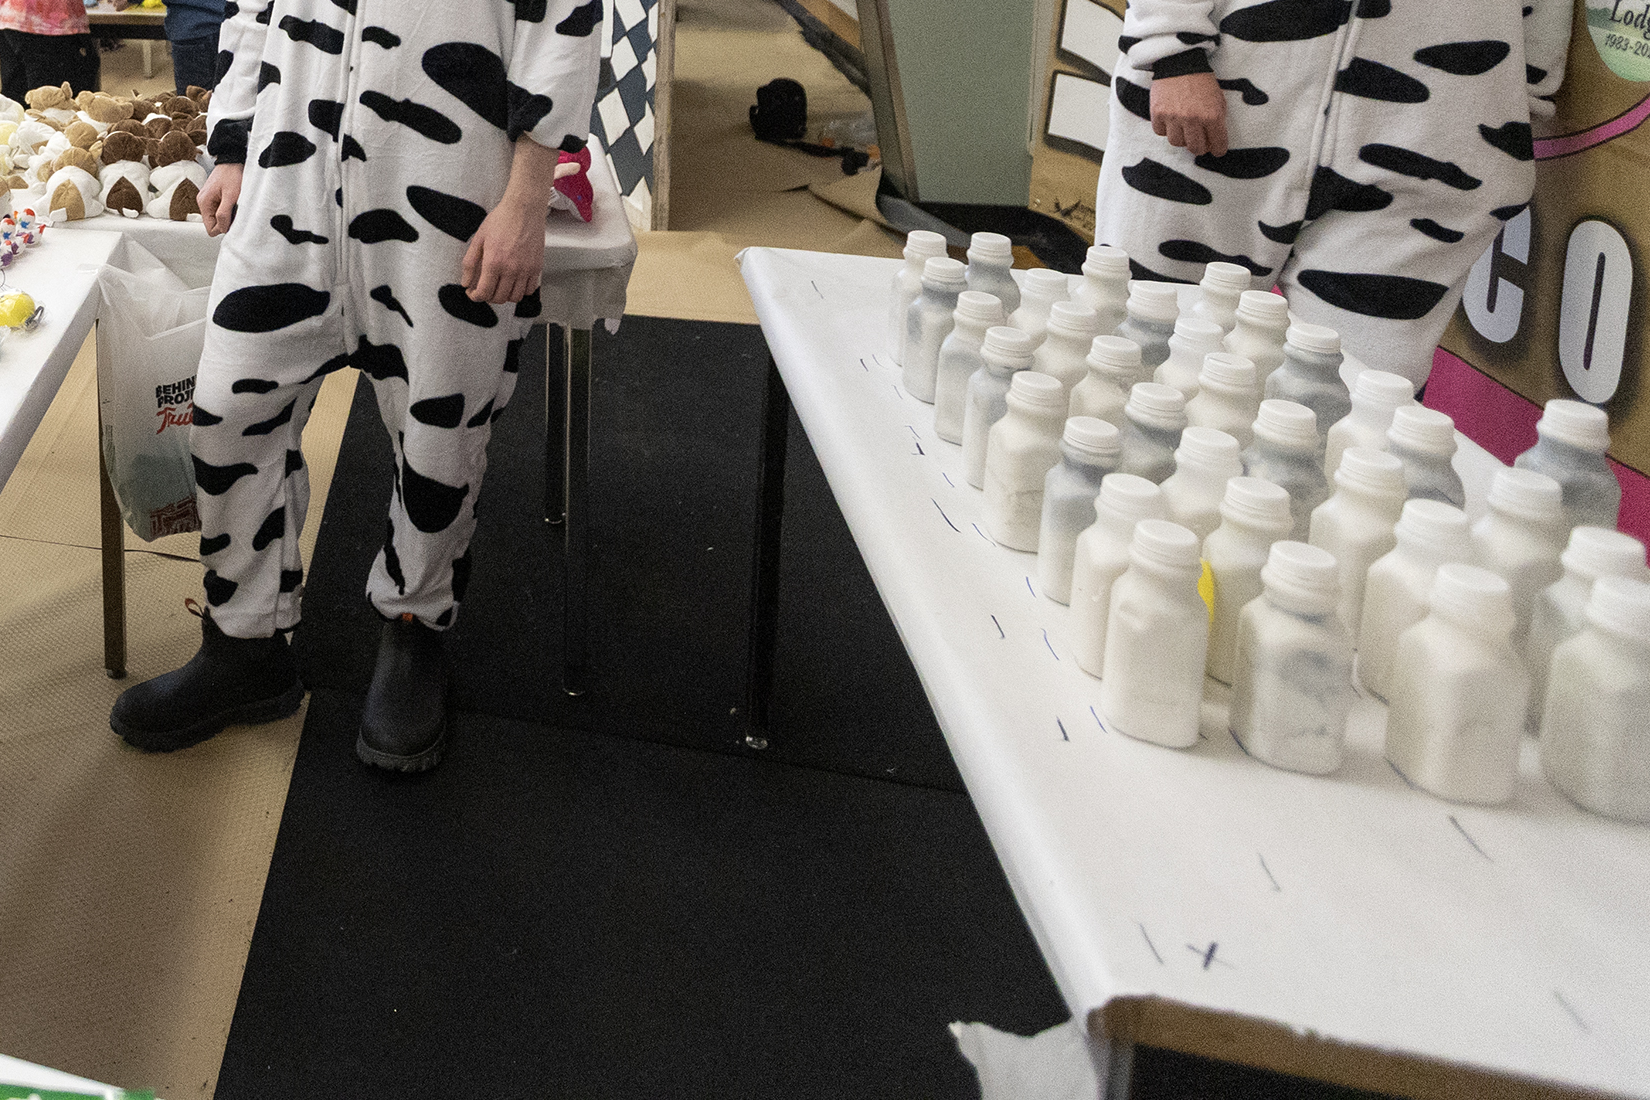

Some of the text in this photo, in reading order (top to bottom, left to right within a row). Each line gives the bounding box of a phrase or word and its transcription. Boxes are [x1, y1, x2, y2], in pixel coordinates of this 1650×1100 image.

[1605, 32, 1650, 59] 1983-20
[155, 374, 198, 399] BEHIN
[157, 388, 195, 409] PROJ
